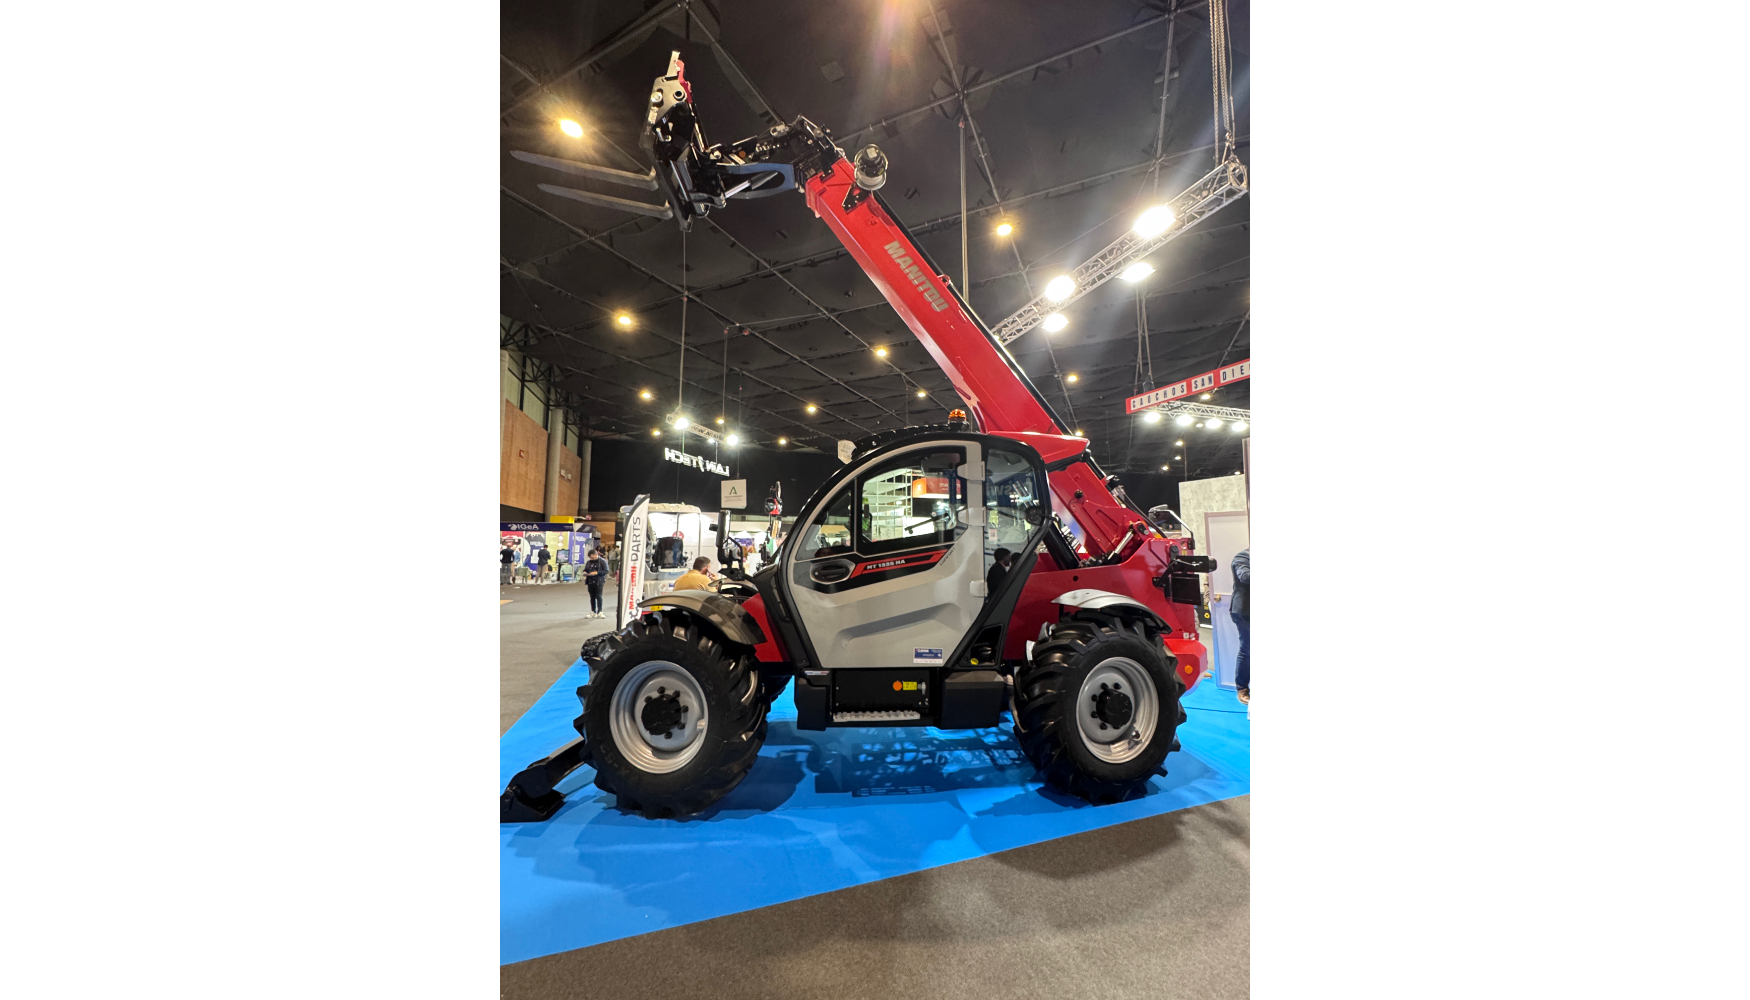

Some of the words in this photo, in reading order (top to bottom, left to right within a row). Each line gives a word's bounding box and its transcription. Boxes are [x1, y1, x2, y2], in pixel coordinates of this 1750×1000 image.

[884, 240, 949, 312] MANITOU
[1132, 384, 1185, 408] CAUCHOS
[1194, 375, 1213, 389] SAN
[1222, 365, 1250, 381] DIE
